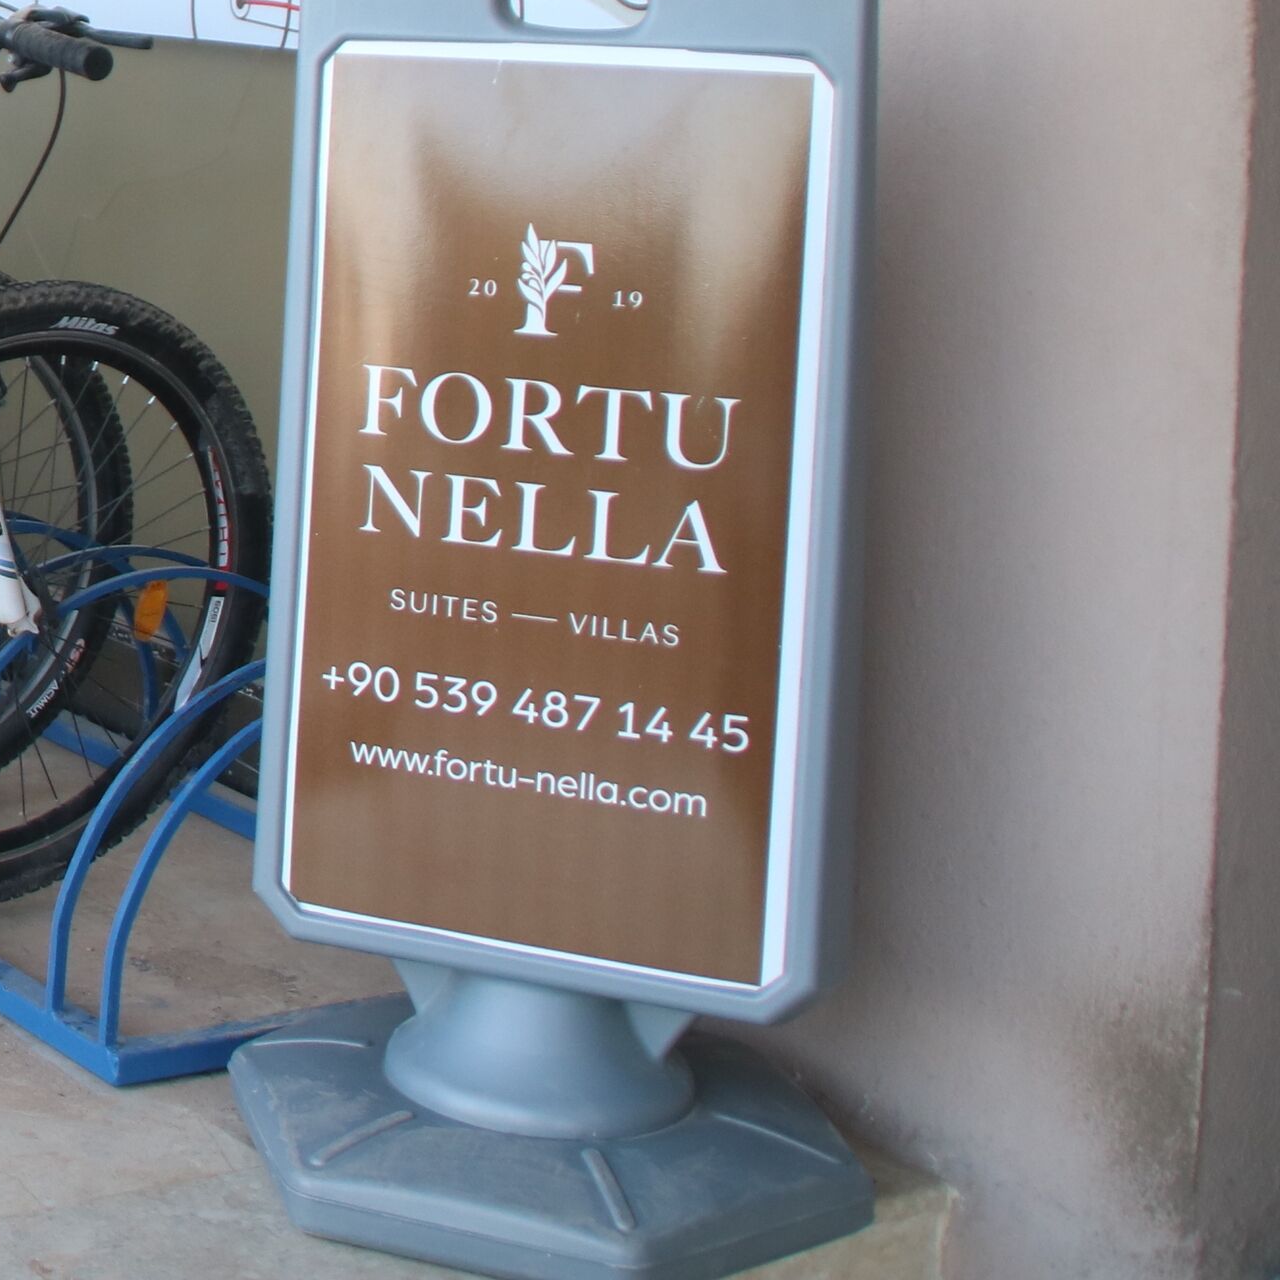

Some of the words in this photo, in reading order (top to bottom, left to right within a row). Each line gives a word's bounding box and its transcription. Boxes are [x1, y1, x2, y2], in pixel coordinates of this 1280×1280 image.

[467, 276, 498, 298] 20
[611, 287, 644, 309] 19
[358, 363, 742, 472] FORTU
[358, 463, 728, 576] NELLA
[389, 587, 499, 624] SUITES
[569, 612, 681, 648] VILLAS
[321, 660, 402, 703] +90
[414, 671, 498, 717] 539
[511, 688, 603, 732] 487
[617, 701, 674, 745] 14
[689, 712, 751, 755] 45
[350, 740, 708, 818] www.fortu-nella.com
